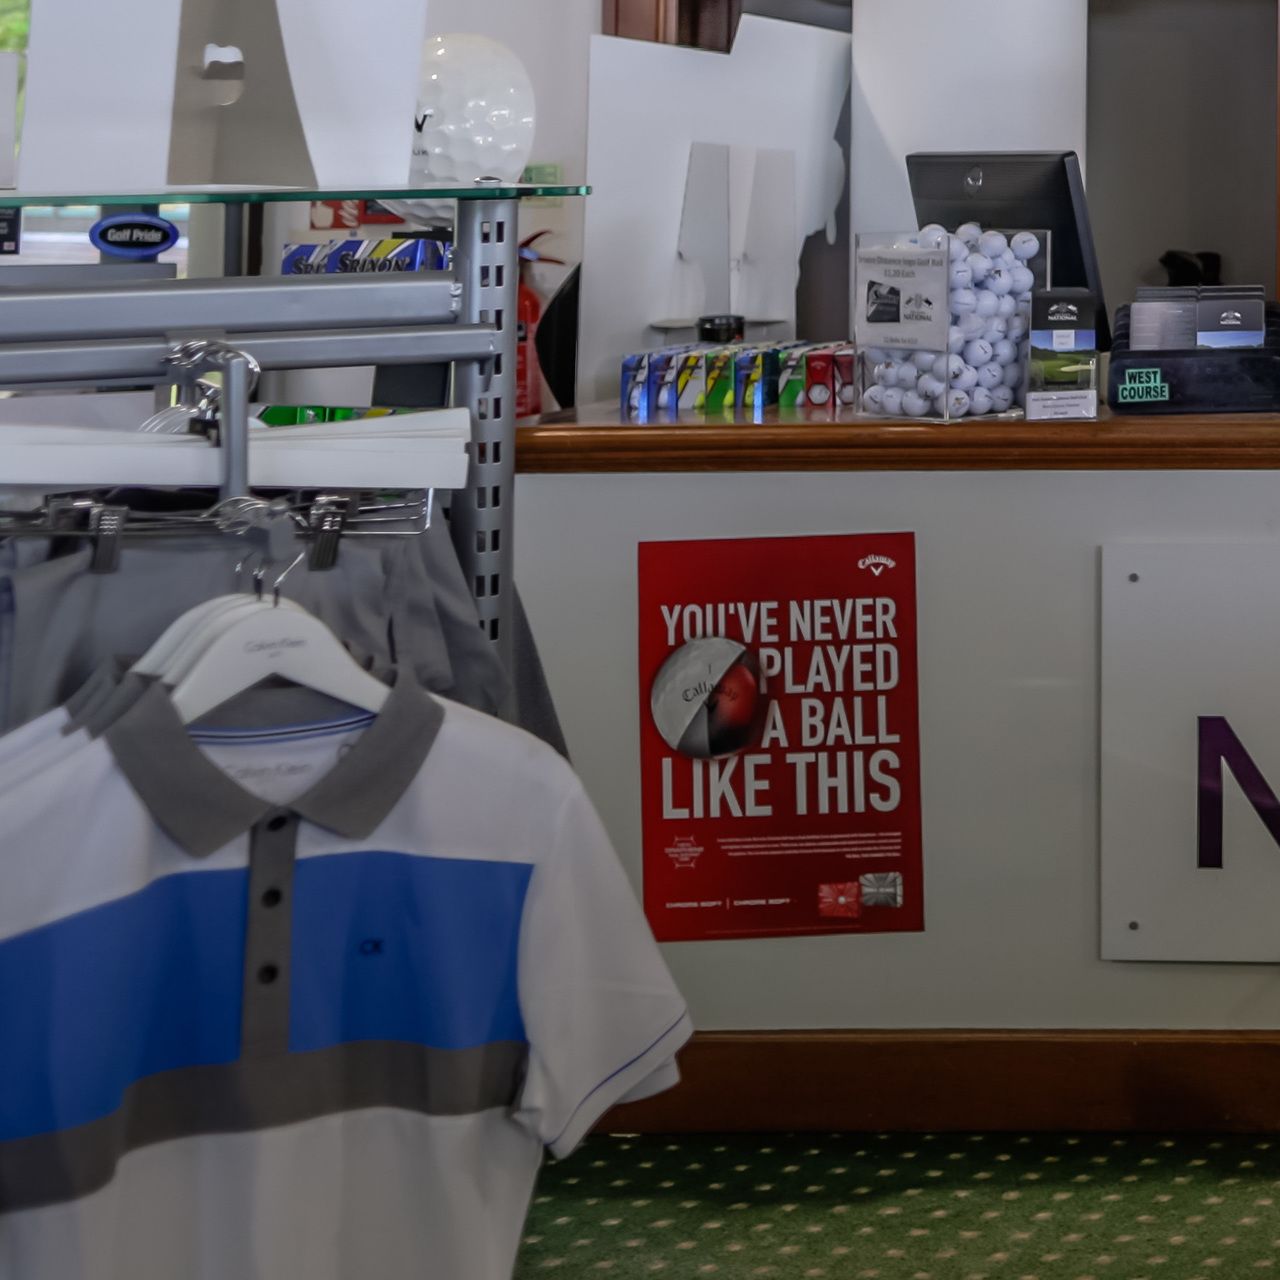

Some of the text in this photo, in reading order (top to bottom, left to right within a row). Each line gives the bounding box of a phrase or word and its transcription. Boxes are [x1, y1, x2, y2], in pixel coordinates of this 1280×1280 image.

[107, 228, 162, 242] Golf Pride
[292, 257, 327, 274] SRI
[1121, 384, 1168, 401] COURSE
[1128, 371, 1159, 385] WEST
[660, 597, 898, 646] YOU'VE NEVER
[760, 644, 899, 695] PLAYED
[761, 695, 900, 748] A BALL
[661, 749, 900, 819] LIKE THIS
